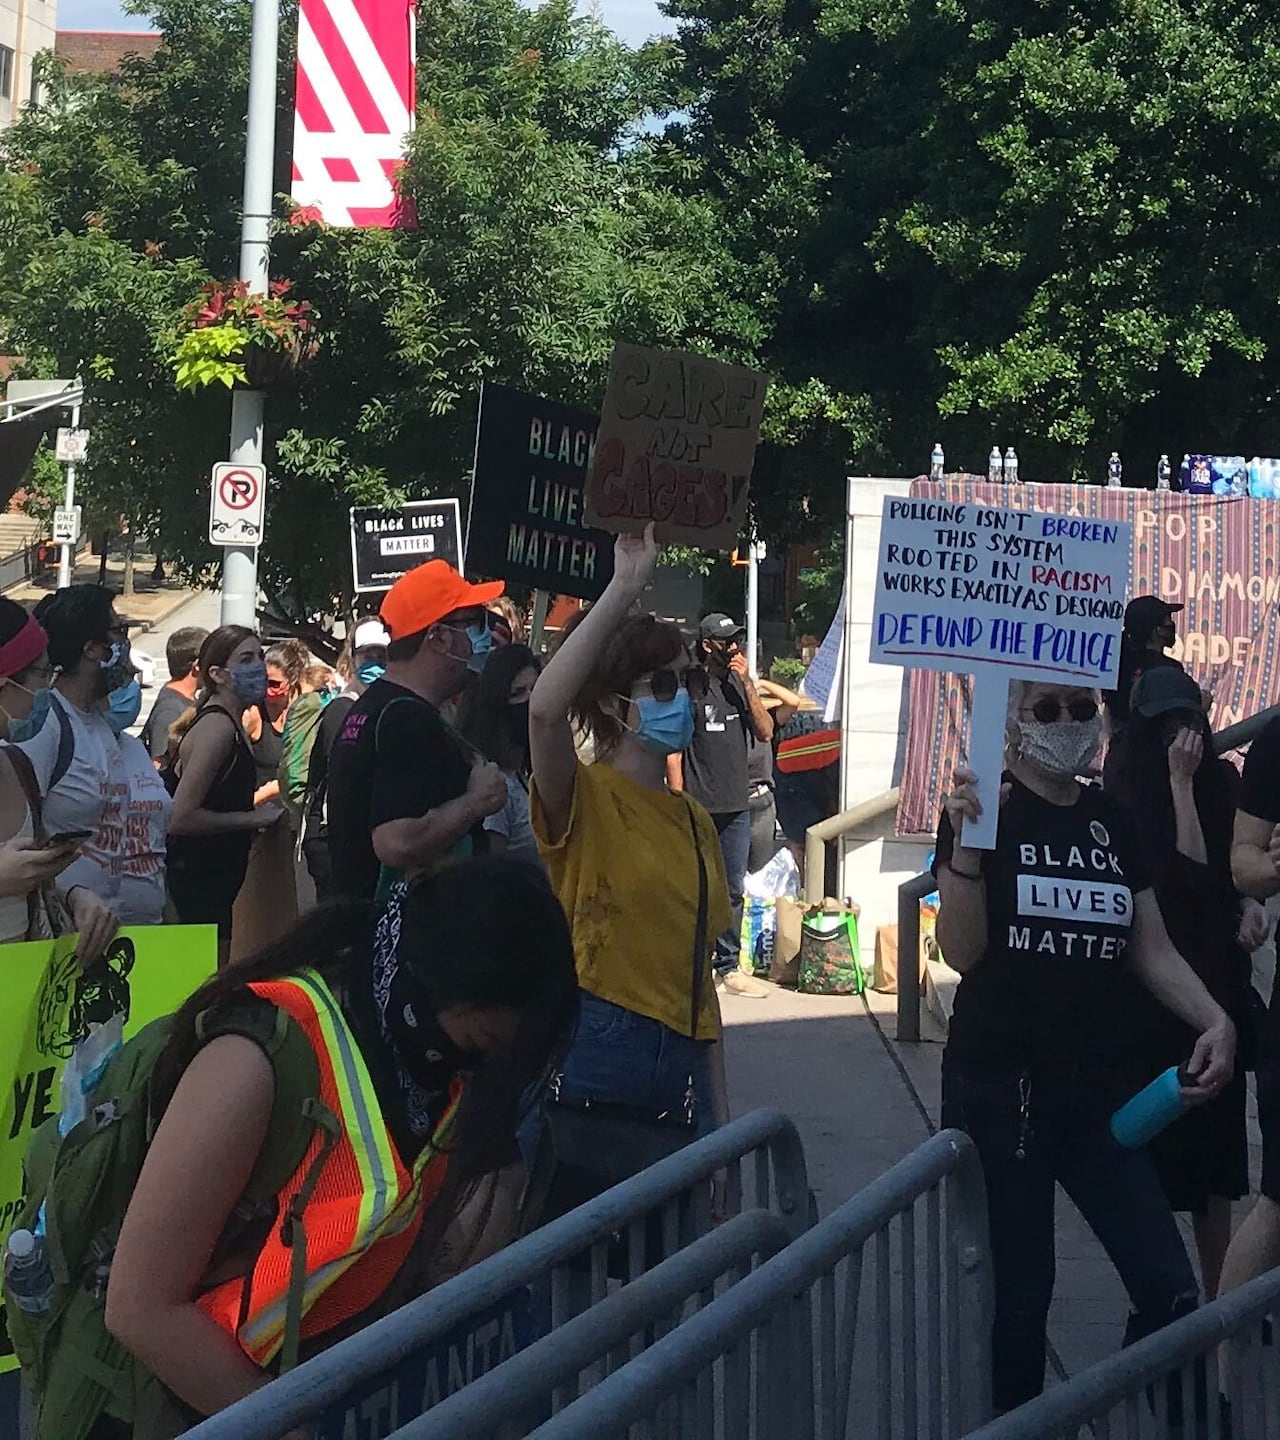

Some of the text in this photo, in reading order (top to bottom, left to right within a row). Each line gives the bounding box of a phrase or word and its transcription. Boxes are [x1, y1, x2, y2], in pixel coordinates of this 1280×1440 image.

[616, 355, 758, 429] CARE
[646, 427, 712, 463] NOT
[365, 515, 444, 533] BLACK LIVES
[890, 501, 967, 525] POLICING
[976, 510, 1032, 532] ISN'T
[1042, 517, 1119, 544] BROKEN
[1135, 510, 1218, 543] POP
[386, 538, 430, 552] MATTER
[507, 523, 597, 581] MATTER
[935, 529, 1063, 565] THIS SYSTEM
[888, 544, 1112, 594] ROOTED IN RACISM
[884, 572, 1125, 620] WORKS EXACTLY AS DESIGNED
[878, 613, 1116, 673] DEFUND THE POLICE
[1020, 843, 1124, 877] BLACK
[1031, 884, 1128, 917] LIVES
